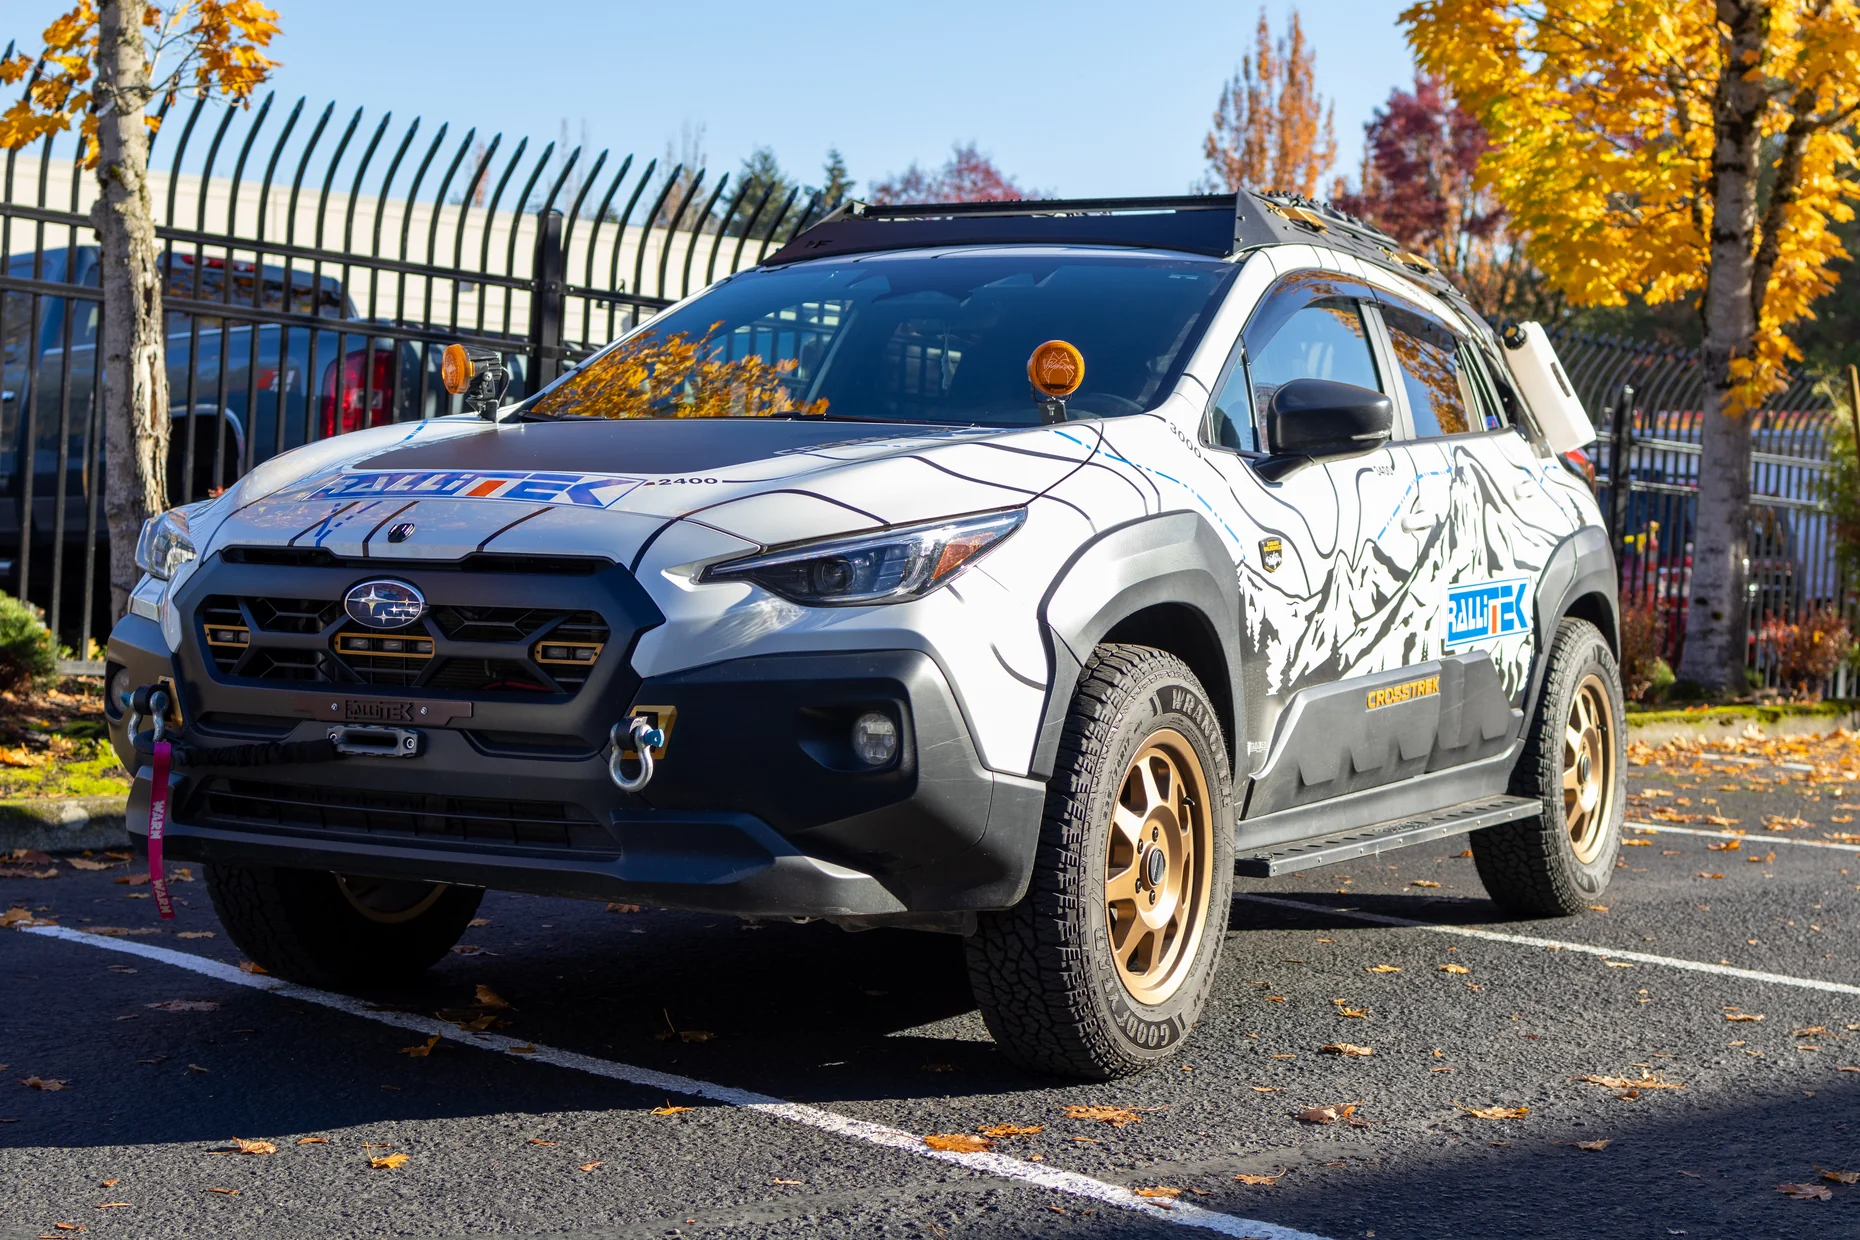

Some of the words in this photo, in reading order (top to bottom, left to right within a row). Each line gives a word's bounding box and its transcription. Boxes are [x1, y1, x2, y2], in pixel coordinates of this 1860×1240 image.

[1169, 422, 1202, 459] 3000
[658, 477, 719, 486] 2400
[1366, 675, 1441, 709] CROSSTREK
[1171, 688, 1232, 808] WRANGLER
[150, 800, 165, 840] WARN
[153, 879, 172, 914] WARN
